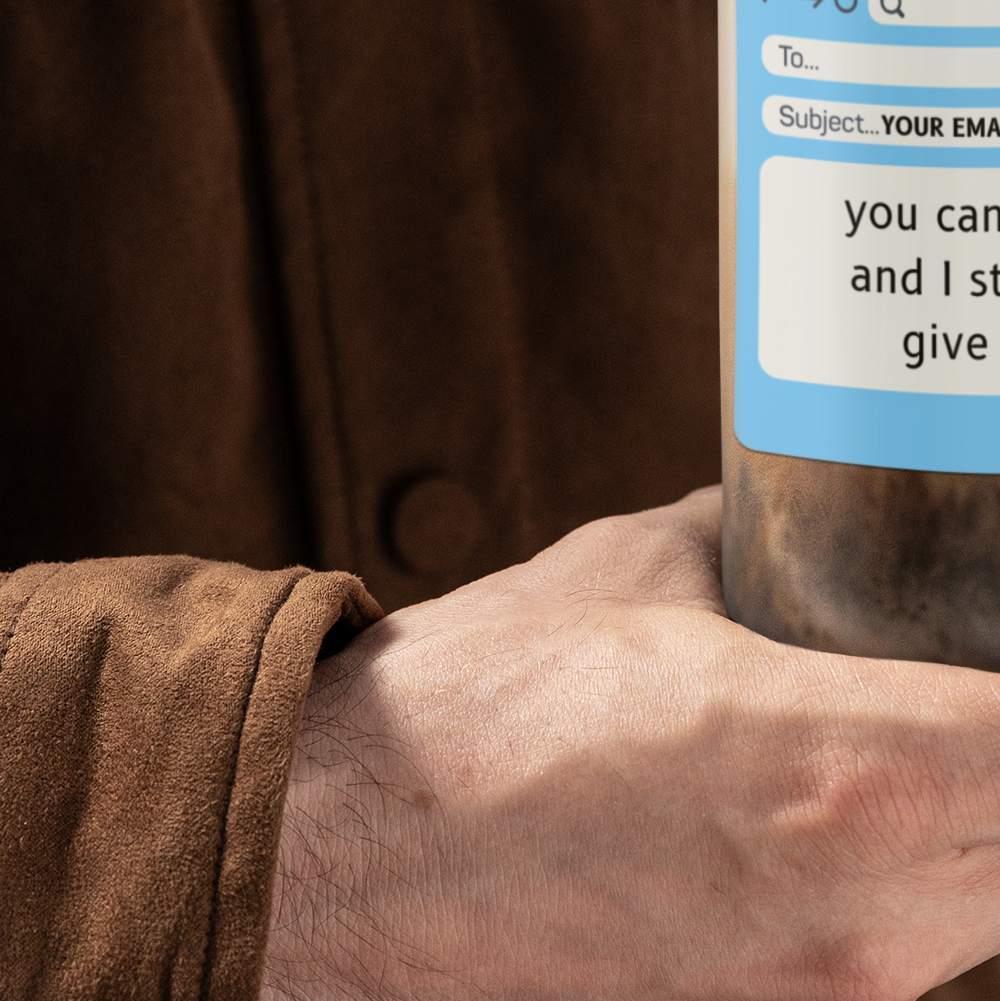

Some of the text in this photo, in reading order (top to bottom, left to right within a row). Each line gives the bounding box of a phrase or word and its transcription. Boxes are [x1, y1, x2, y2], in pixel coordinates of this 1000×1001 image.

[778, 44, 819, 71] To...
[844, 199, 917, 238] you
[850, 256, 923, 296] and
[942, 259, 952, 297] I
[902, 323, 988, 370] give
